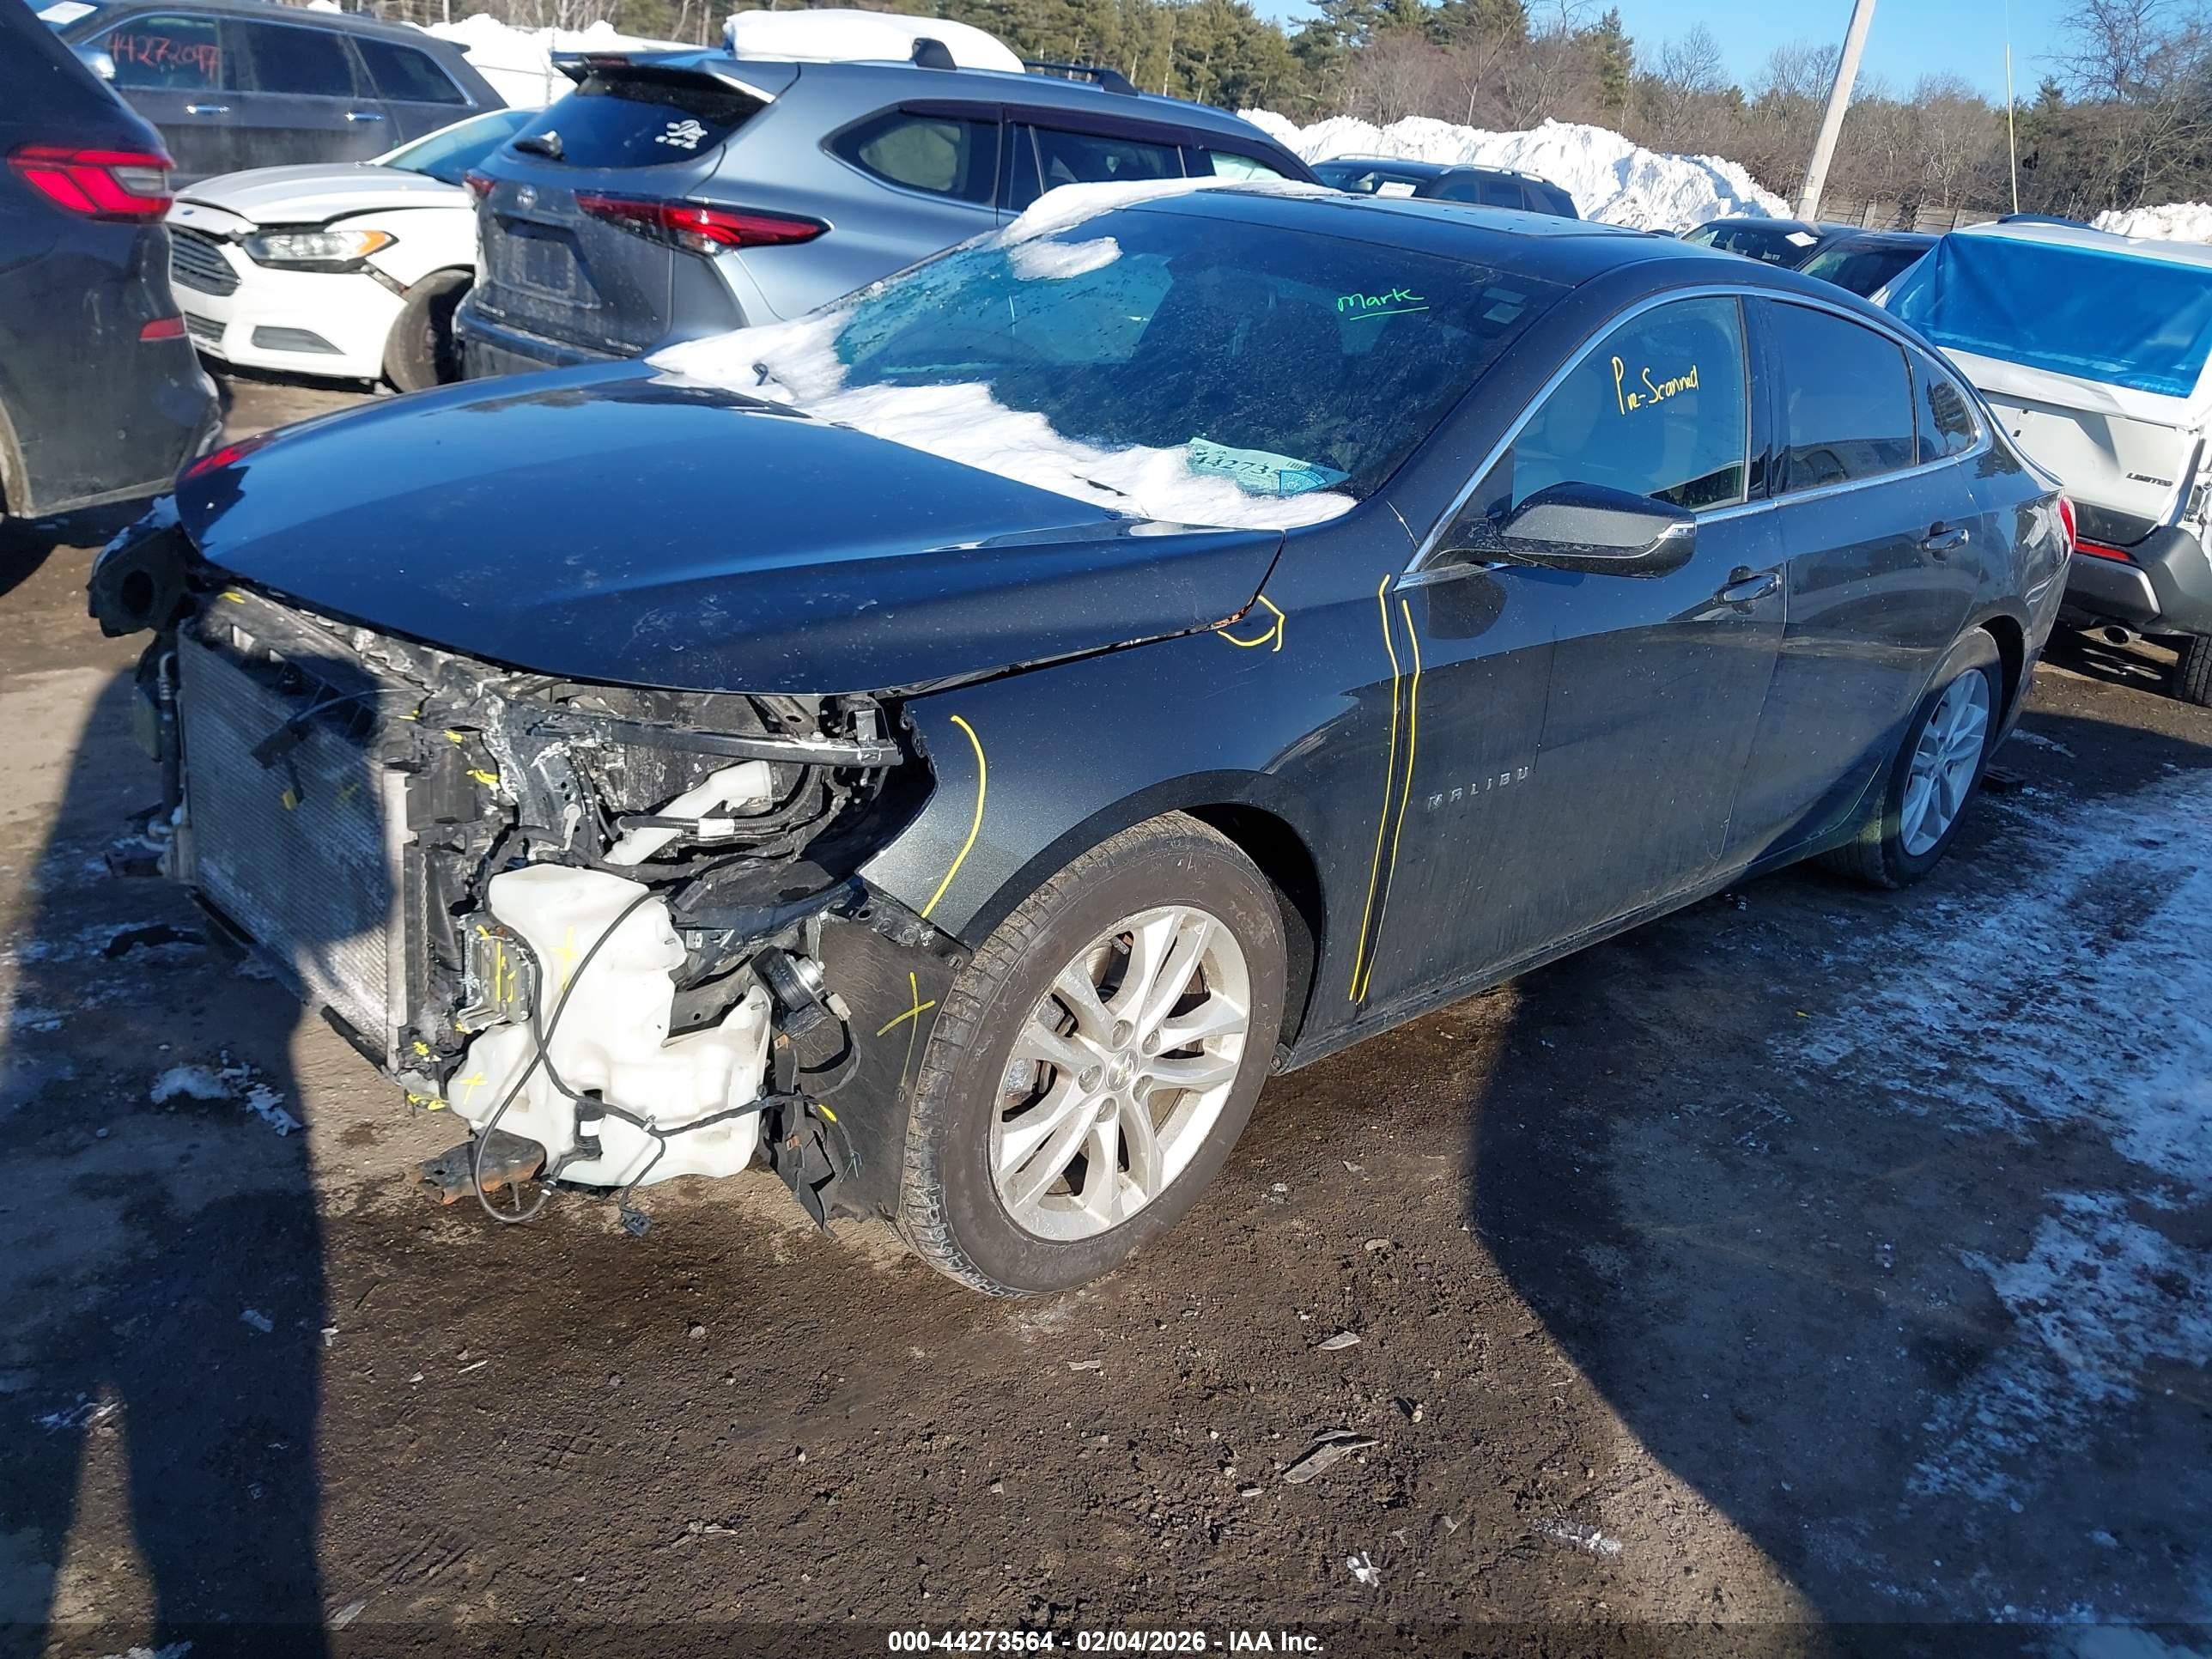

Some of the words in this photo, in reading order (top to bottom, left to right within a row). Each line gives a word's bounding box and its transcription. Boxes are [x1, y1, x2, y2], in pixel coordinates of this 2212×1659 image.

[1337, 288, 1425, 312] Mark
[2125, 472, 2175, 487] LIMITED
[1426, 766, 1529, 812] MALIBU
